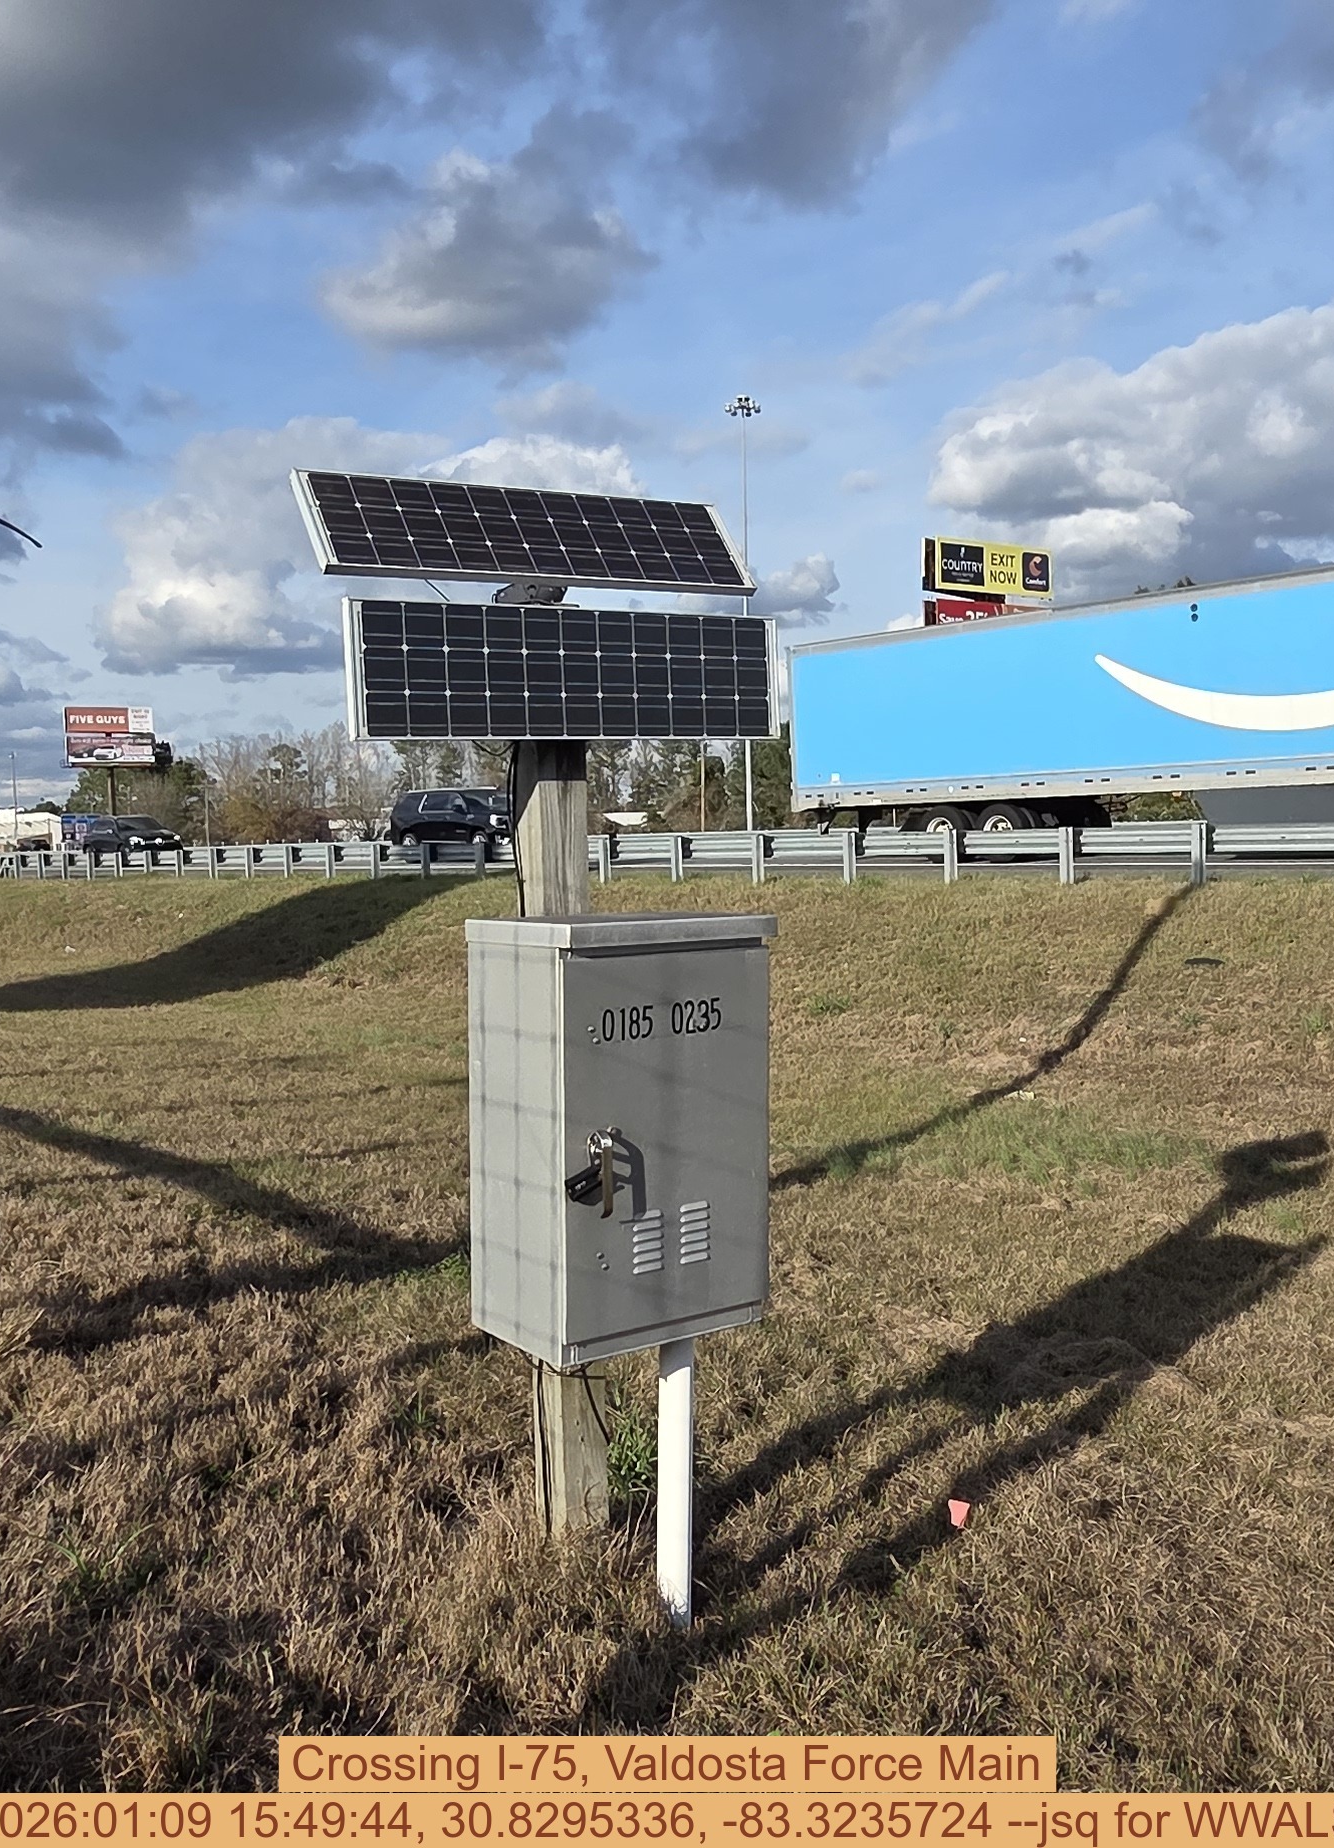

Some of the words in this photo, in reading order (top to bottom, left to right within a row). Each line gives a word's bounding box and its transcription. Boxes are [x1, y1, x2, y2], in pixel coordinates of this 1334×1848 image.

[942, 559, 982, 572] COUNTRY
[991, 553, 1015, 567] EXIT
[990, 570, 1017, 584] NOW
[69, 714, 94, 724] FIVE
[95, 714, 126, 724] GUYS
[602, 1005, 654, 1042] 0185
[671, 997, 722, 1035] 0235
